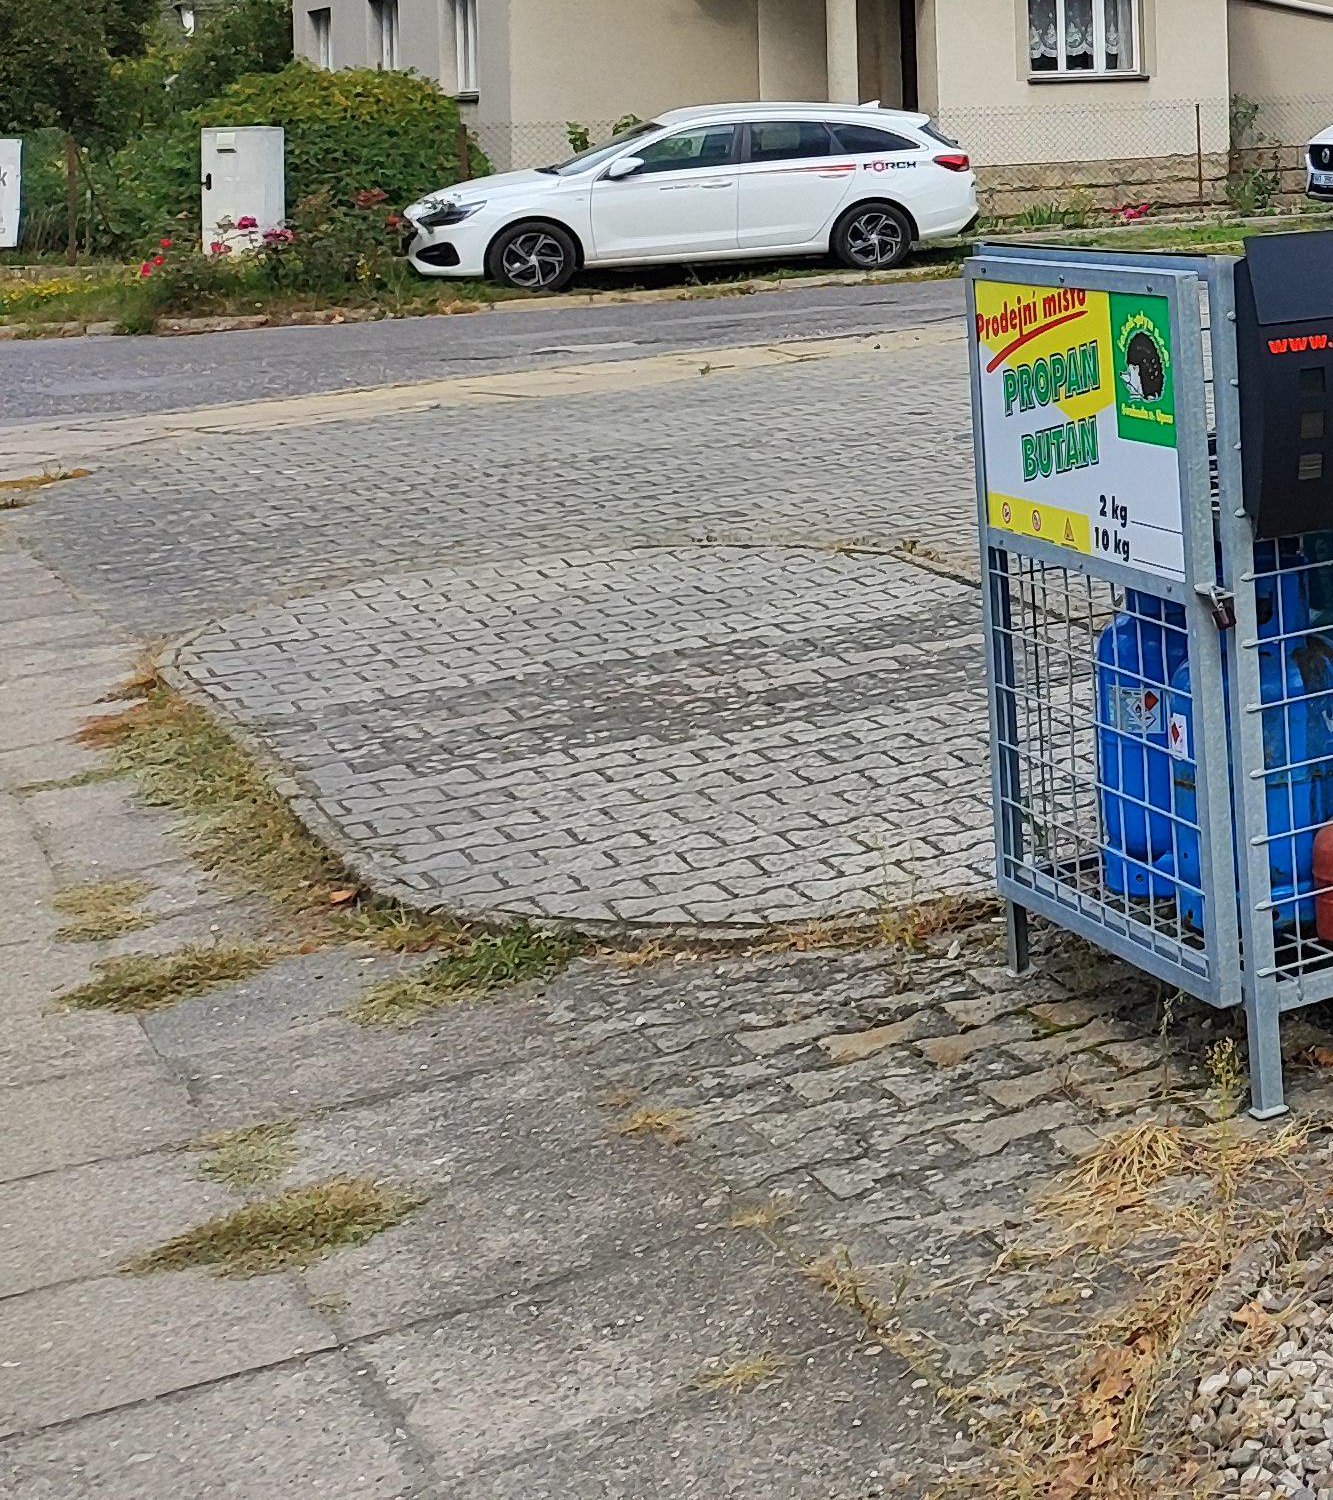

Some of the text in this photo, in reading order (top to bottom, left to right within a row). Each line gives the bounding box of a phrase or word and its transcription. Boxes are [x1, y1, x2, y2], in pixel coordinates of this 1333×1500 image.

[976, 290, 1038, 342] Prodejní
[1002, 339, 1101, 418] PROPAN
[1020, 414, 1100, 483] BUTAN
[1099, 494, 1128, 529] 2 kg
[1094, 526, 1130, 562] 10 kg
